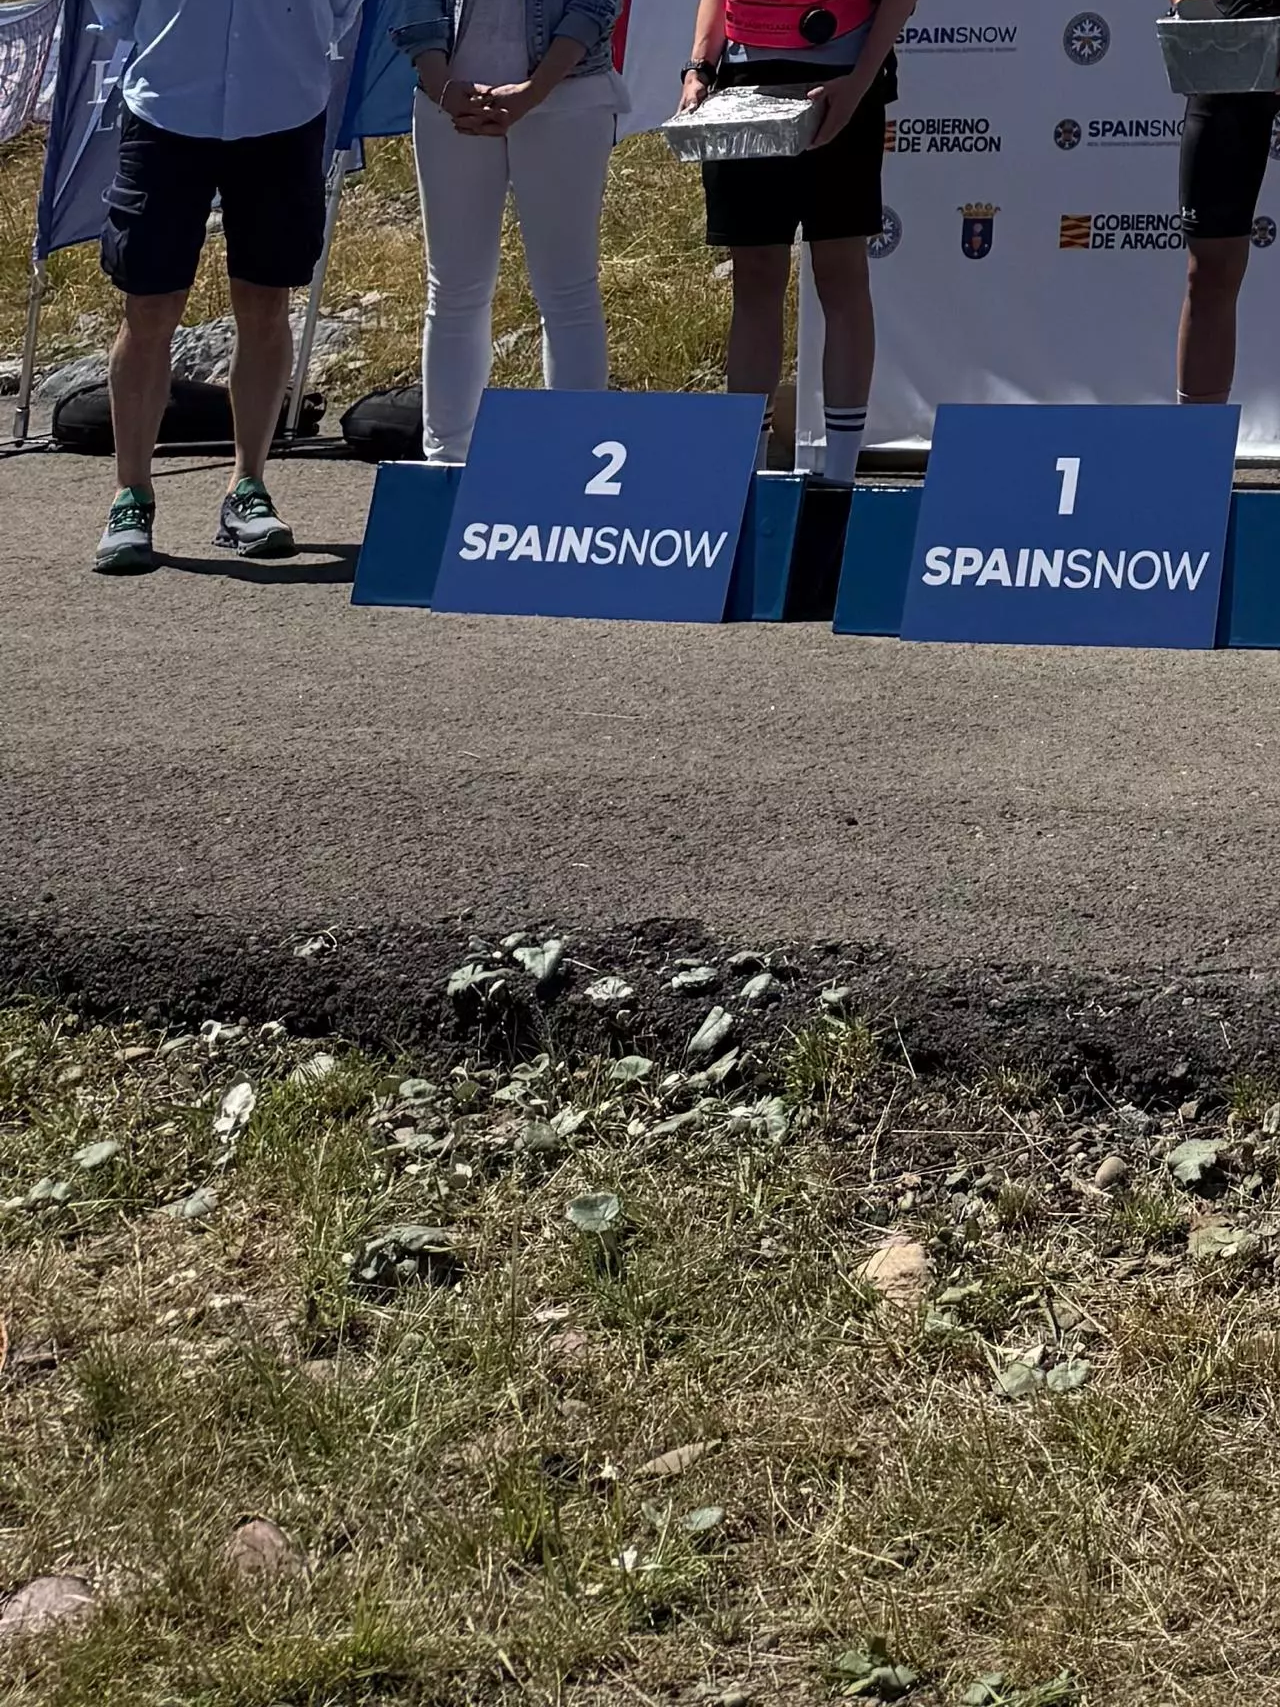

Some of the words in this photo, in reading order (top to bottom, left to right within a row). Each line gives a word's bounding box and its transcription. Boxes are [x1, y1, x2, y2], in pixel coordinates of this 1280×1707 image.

[895, 26, 1018, 44] SPAINSNOW
[899, 118, 990, 135] GOBIERNO
[897, 137, 921, 154] DE
[926, 136, 1001, 154] ARAGON
[1091, 234, 1115, 250] DE
[584, 441, 628, 496] 2
[1055, 457, 1081, 515] 1
[458, 523, 729, 569] SPAINSNOW
[921, 546, 1211, 592] SPAINSNOW
